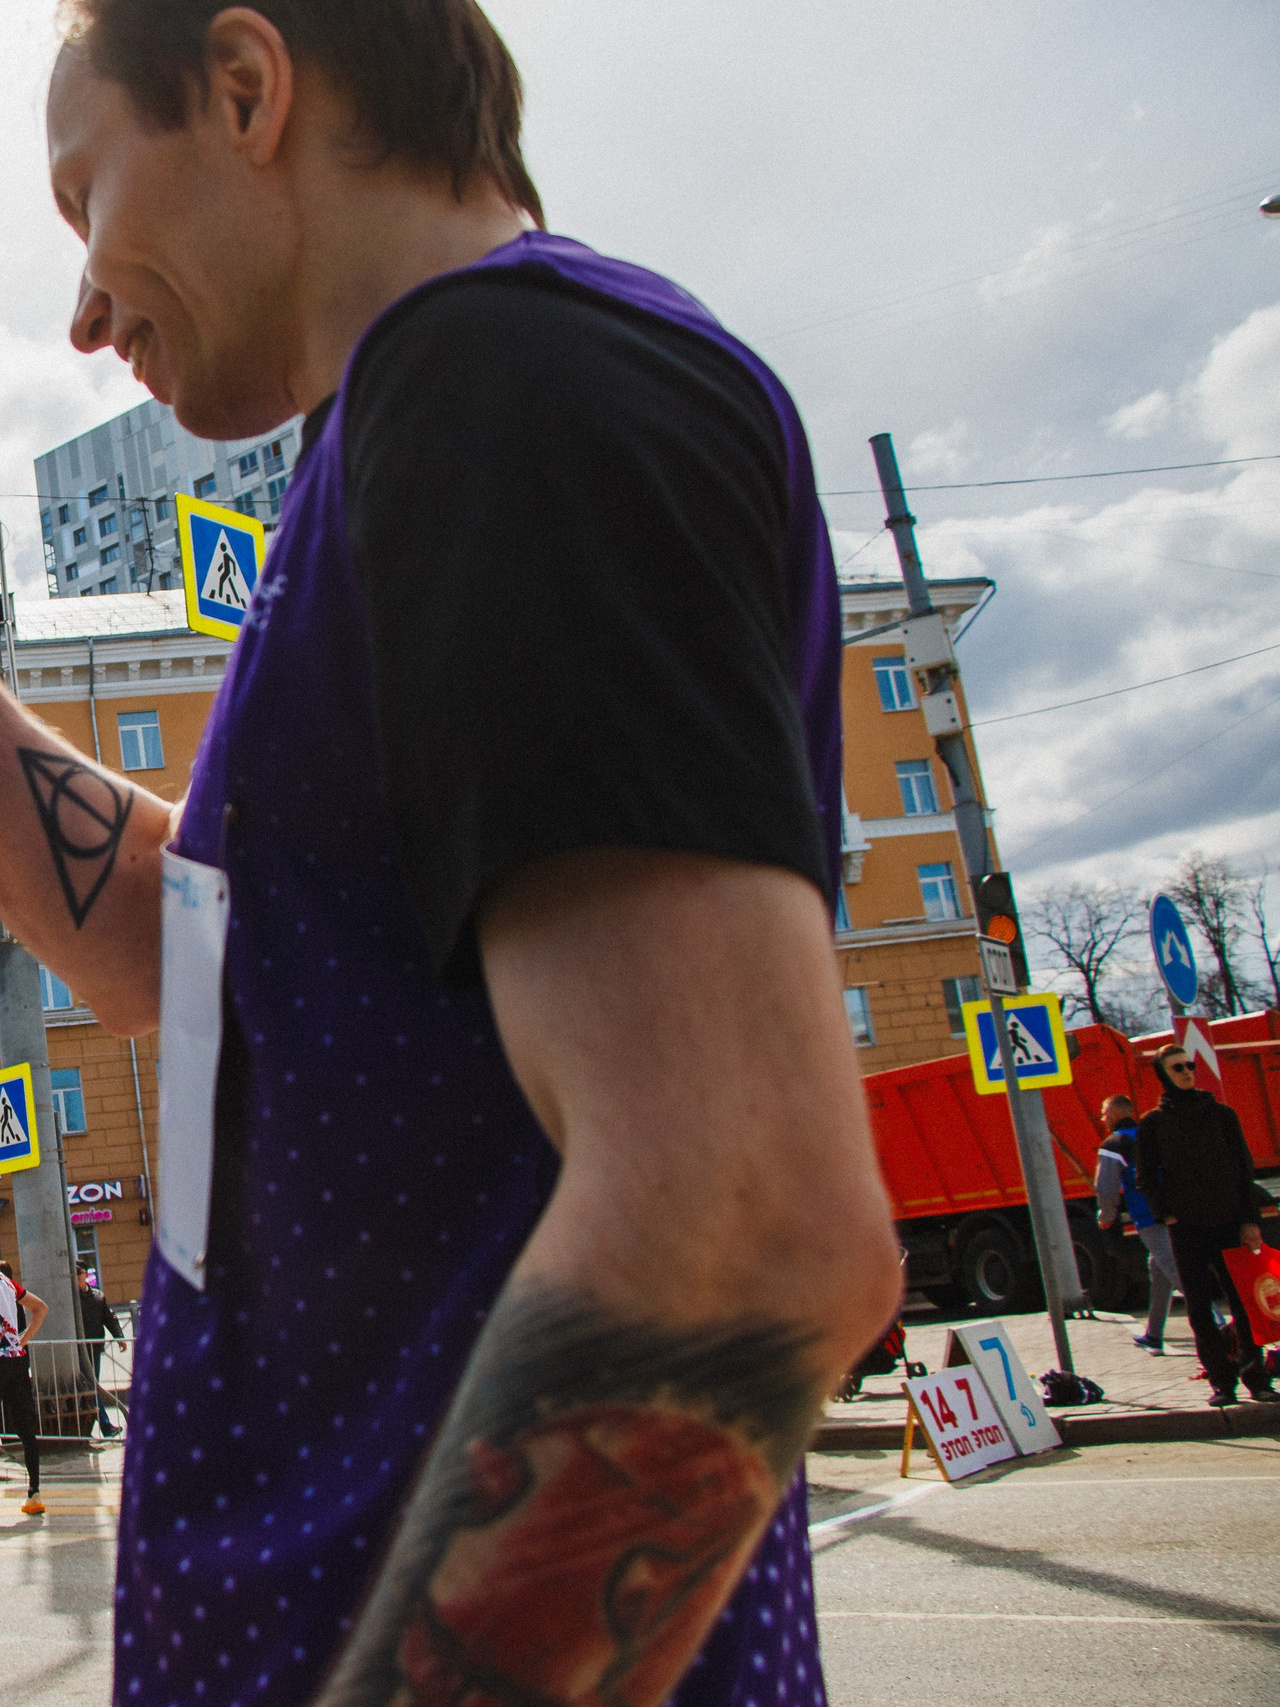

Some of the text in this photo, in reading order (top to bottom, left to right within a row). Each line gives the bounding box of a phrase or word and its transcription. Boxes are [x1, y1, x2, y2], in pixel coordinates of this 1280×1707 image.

[979, 1337, 1017, 1401] 7
[920, 1378, 979, 1433] 14 7
